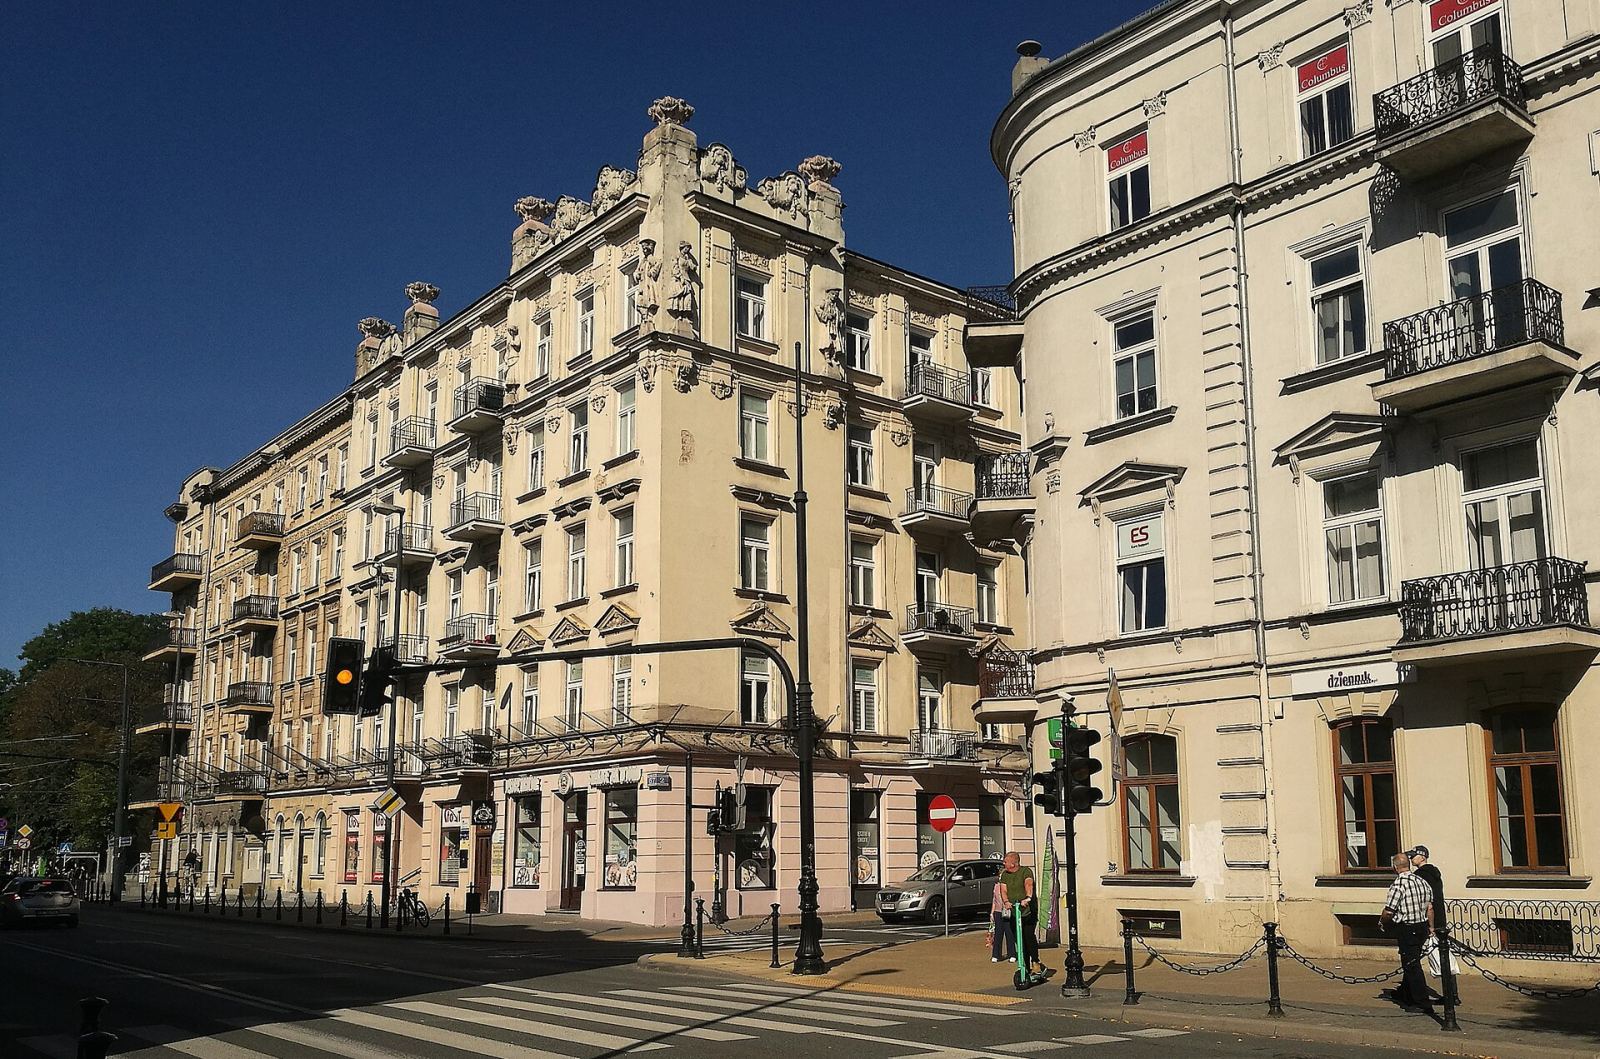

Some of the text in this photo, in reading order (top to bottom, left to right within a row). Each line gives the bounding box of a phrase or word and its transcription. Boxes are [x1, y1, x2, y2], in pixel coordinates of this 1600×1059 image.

[1301, 63, 1346, 89] Columbus
[1110, 148, 1147, 169] Columbus
[1131, 525, 1149, 543] ES
